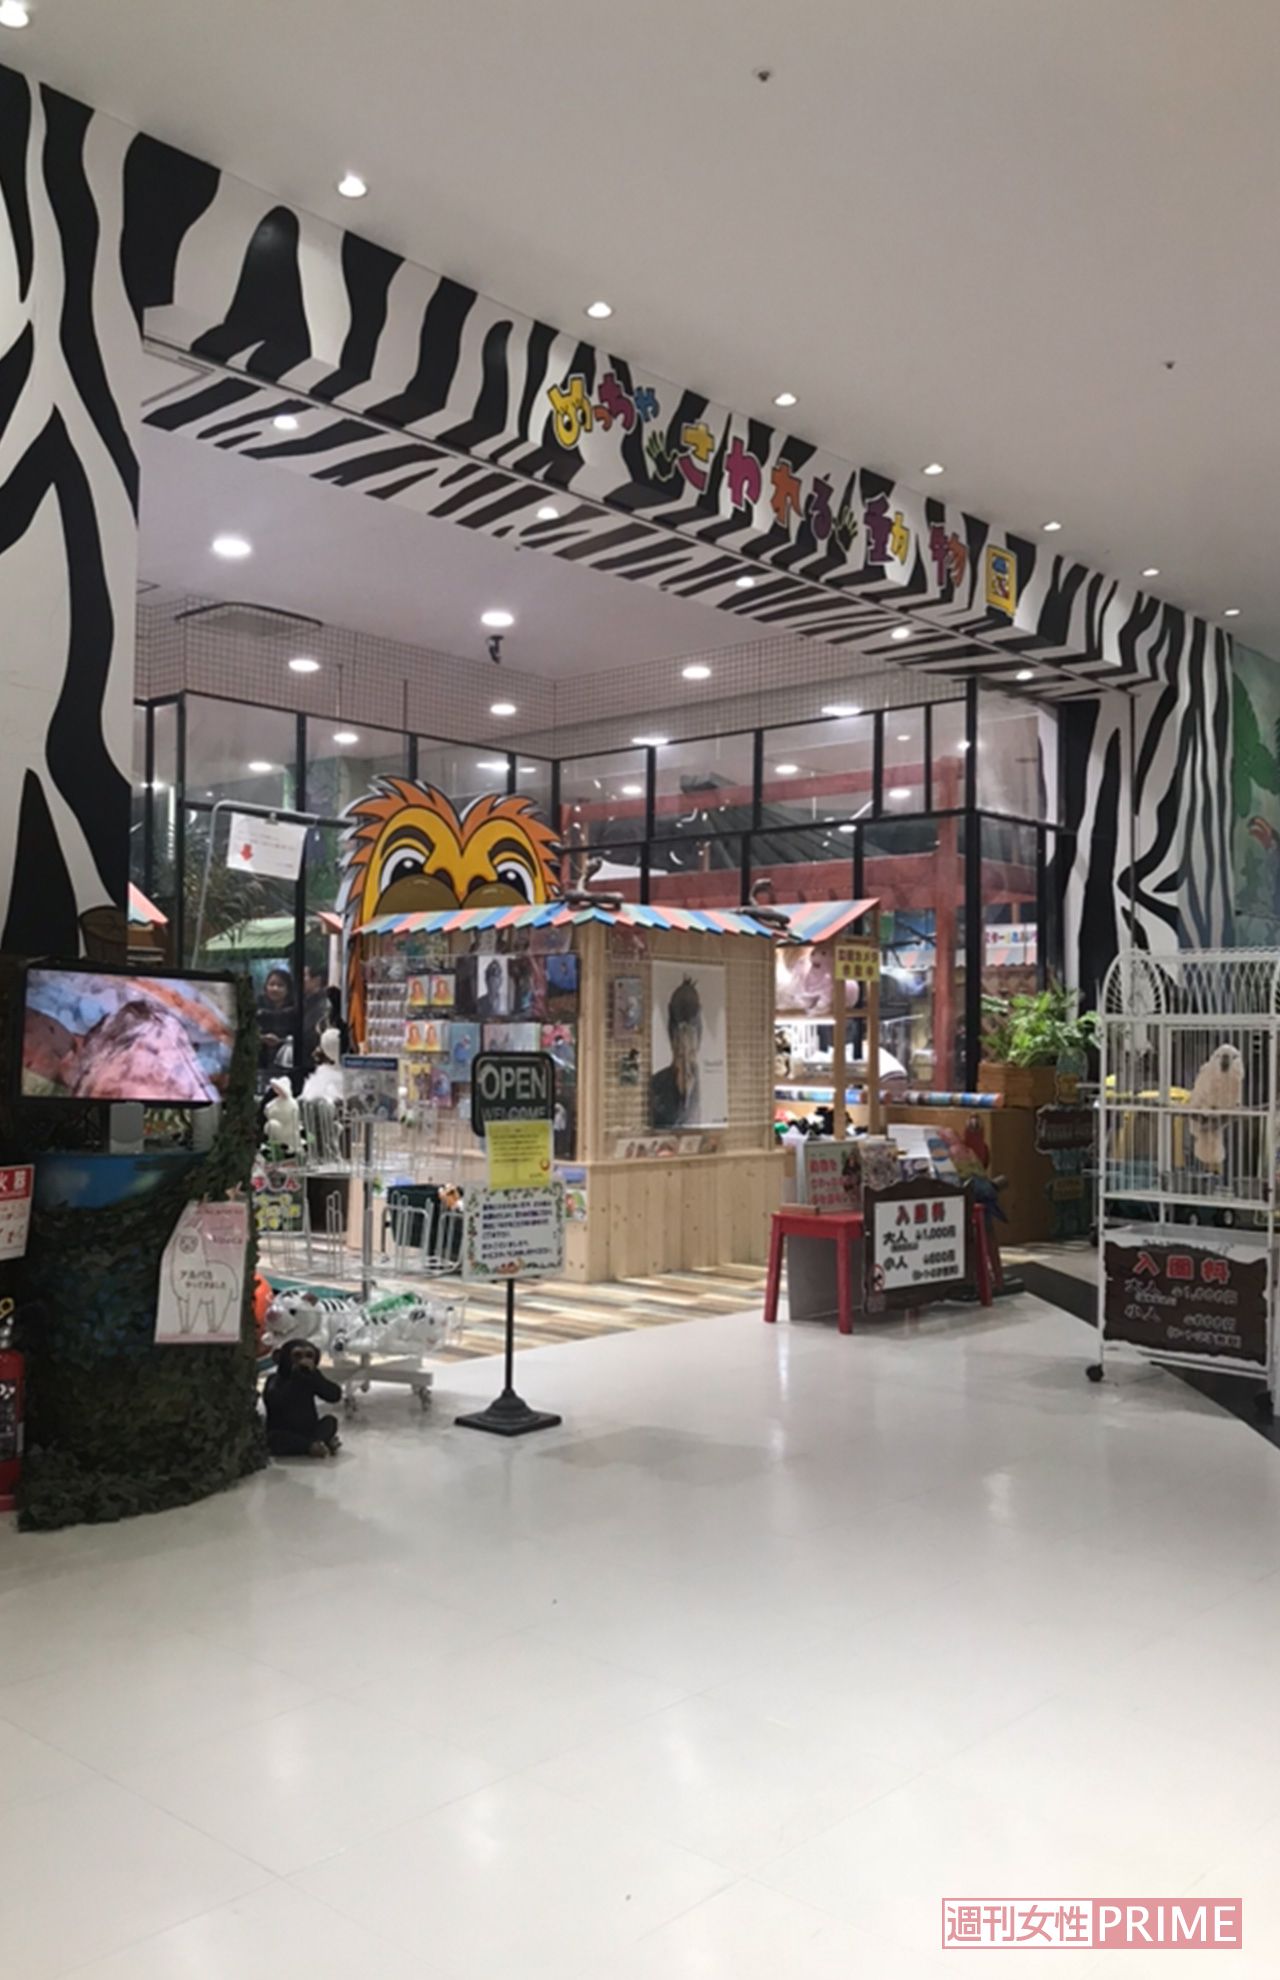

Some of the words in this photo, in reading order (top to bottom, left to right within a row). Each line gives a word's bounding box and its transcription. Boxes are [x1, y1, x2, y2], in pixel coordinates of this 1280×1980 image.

[547, 372, 659, 448] めっちゃ
[677, 421, 834, 541] さわれる
[481, 1063, 547, 1099] OPEN
[895, 1201, 946, 1226] 入園料
[883, 1230, 908, 1246] 大人
[1132, 1251, 1230, 1284] 入園料
